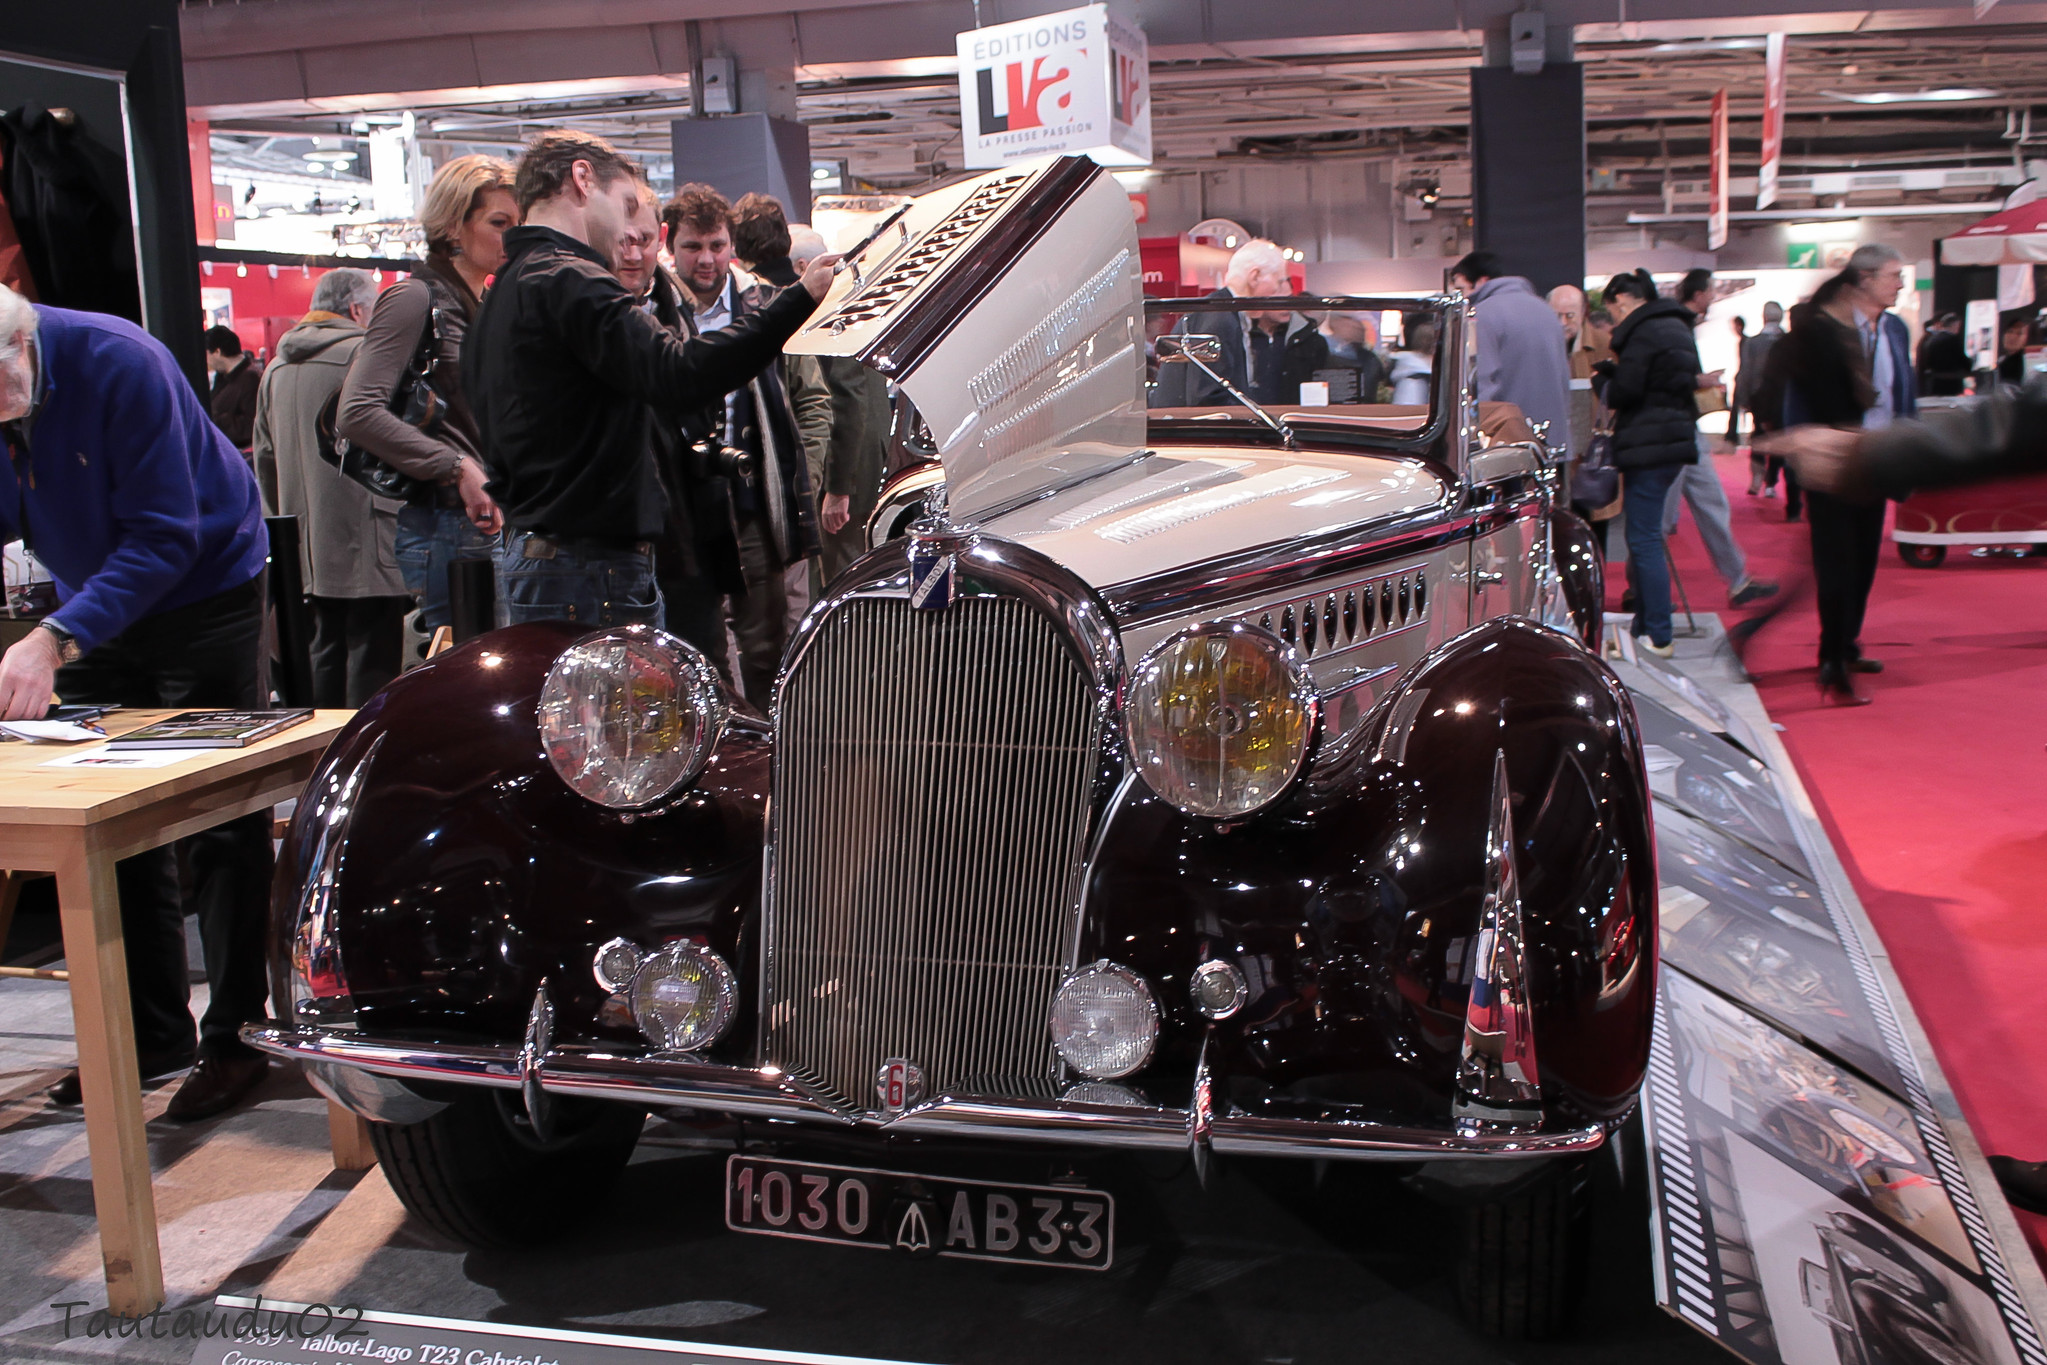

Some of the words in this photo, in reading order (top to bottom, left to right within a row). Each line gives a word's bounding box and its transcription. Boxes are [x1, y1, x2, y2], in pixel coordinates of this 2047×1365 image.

[974, 20, 1087, 61] ÉDITIONS
[978, 138, 991, 149] LA
[996, 130, 1038, 145] PRESSE
[1043, 122, 1093, 138] PASSION
[914, 560, 947, 600] TALBOT
[888, 1064, 904, 1106] 6
[737, 1167, 869, 1235] 1030
[300, 1331, 413, 1364] Talbot-Lago
[418, 1344, 461, 1365] T23
